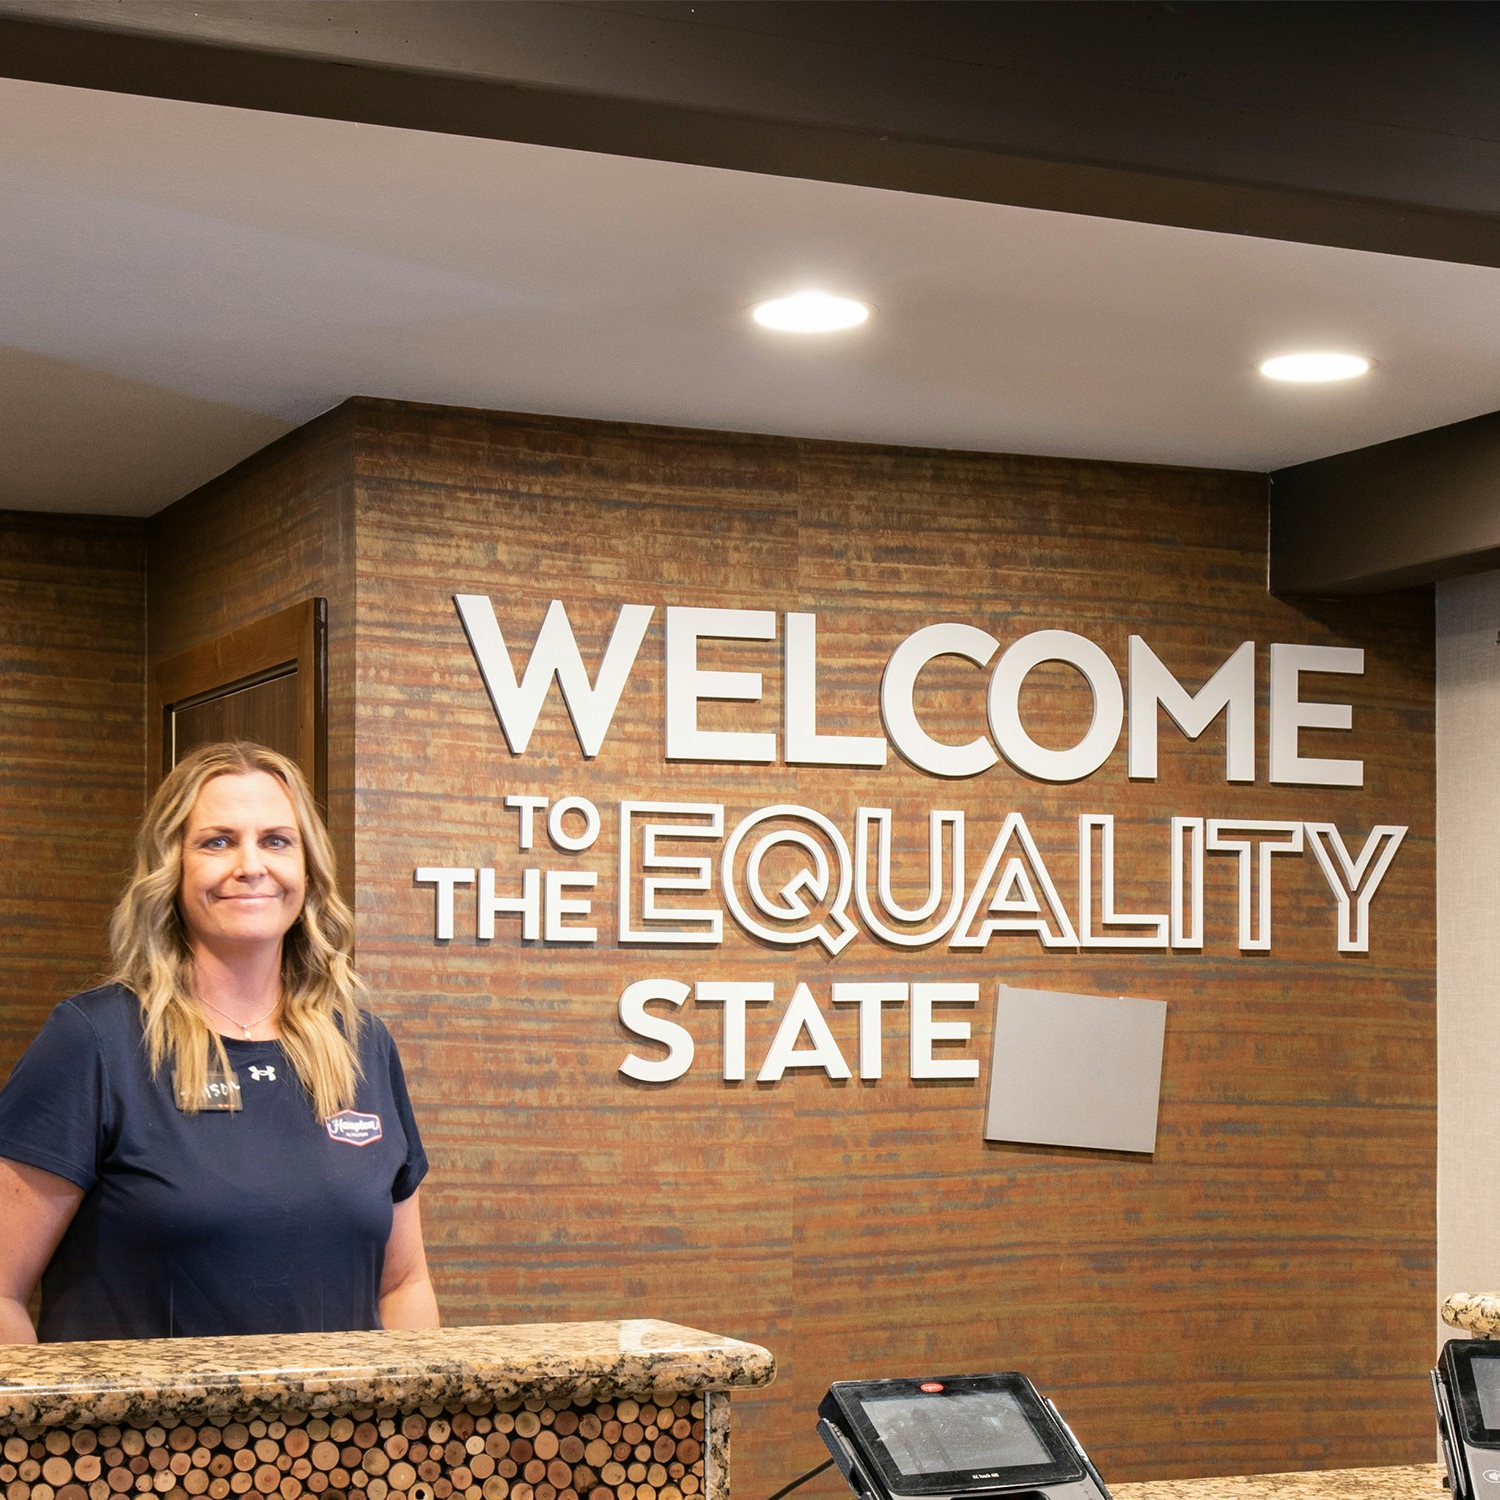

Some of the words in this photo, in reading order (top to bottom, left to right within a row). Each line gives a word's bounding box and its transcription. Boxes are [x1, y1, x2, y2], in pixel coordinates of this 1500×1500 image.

[454, 594, 1365, 786] WELCOME
[415, 867, 598, 943] THE
[618, 800, 1408, 956] EQUALITY
[505, 795, 601, 852] TO
[617, 978, 981, 1083] STATE
